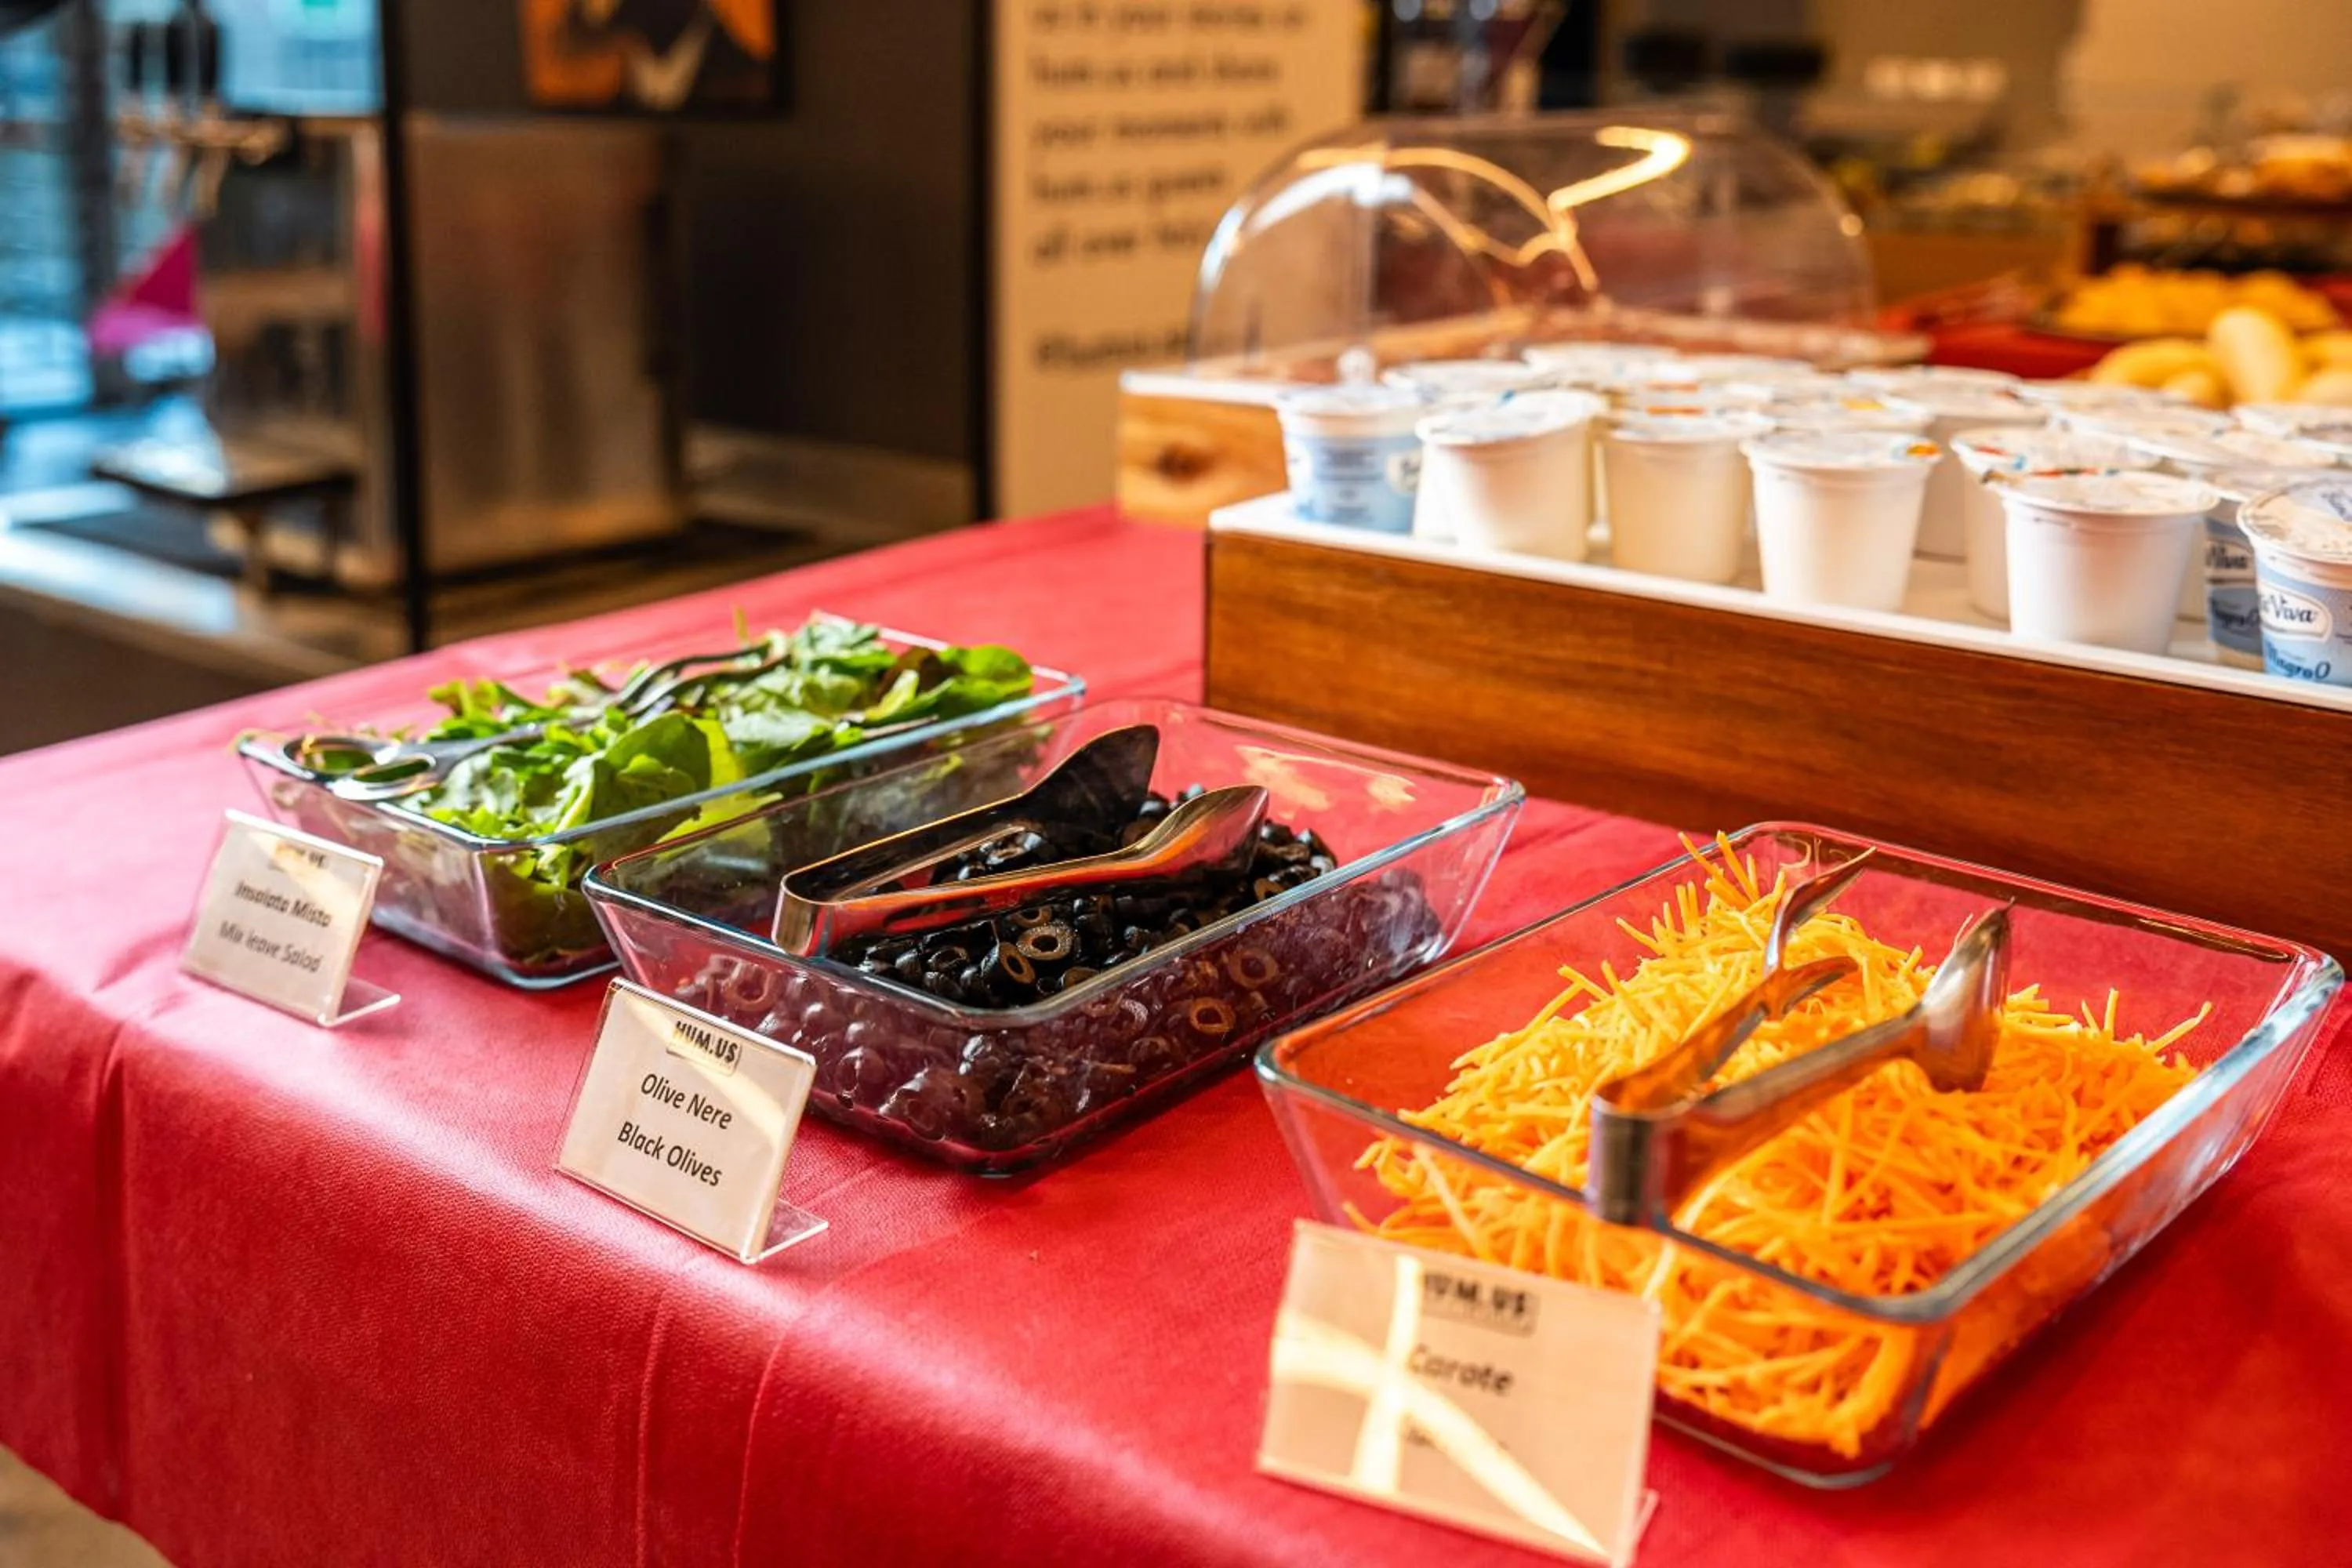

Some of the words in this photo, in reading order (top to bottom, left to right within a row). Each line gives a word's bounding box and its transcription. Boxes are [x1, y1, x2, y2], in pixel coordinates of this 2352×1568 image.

[235, 880, 290, 913] Insalata
[290, 899, 333, 928] Mista
[281, 943, 325, 974] Salad
[641, 1073, 686, 1109] Olive
[686, 1093, 733, 1130] Nere
[616, 1121, 665, 1161] Black
[666, 1145, 724, 1187] Olives
[1408, 1342, 1515, 1397] Carote
